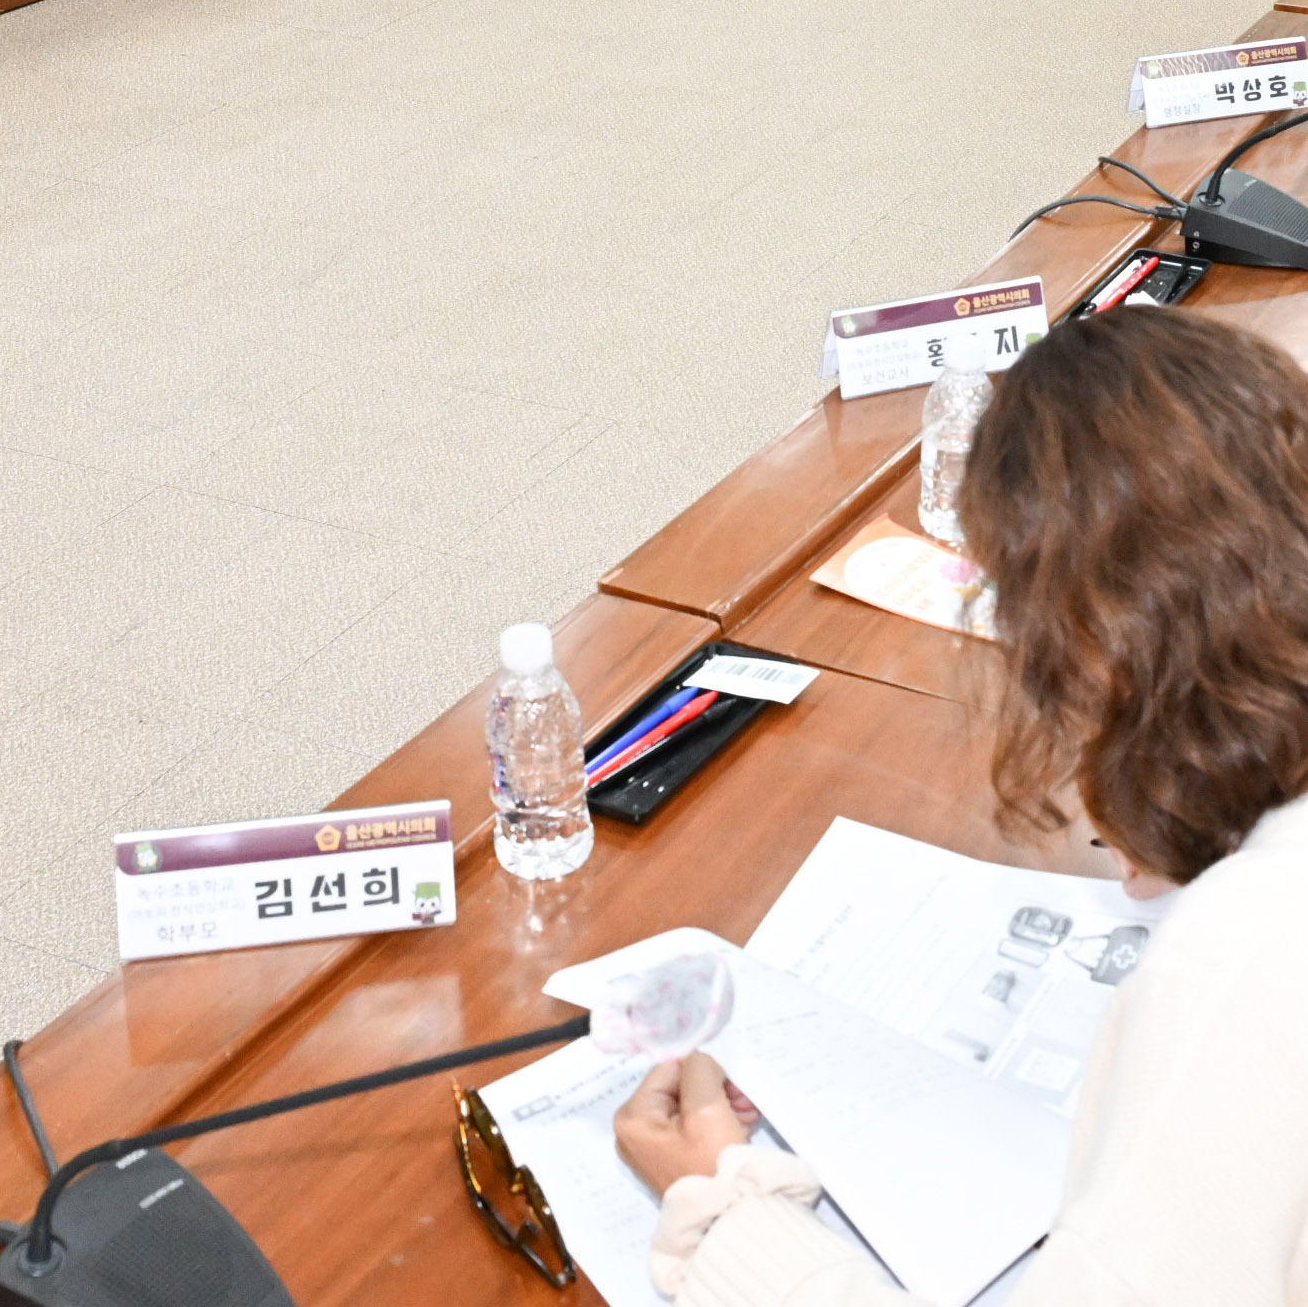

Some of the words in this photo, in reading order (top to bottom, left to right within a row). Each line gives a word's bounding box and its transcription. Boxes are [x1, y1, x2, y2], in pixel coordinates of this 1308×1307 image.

[1214, 74, 1289, 105] 박상호
[254, 866, 401, 919] 김선희
[157, 921, 219, 943] 학부모
